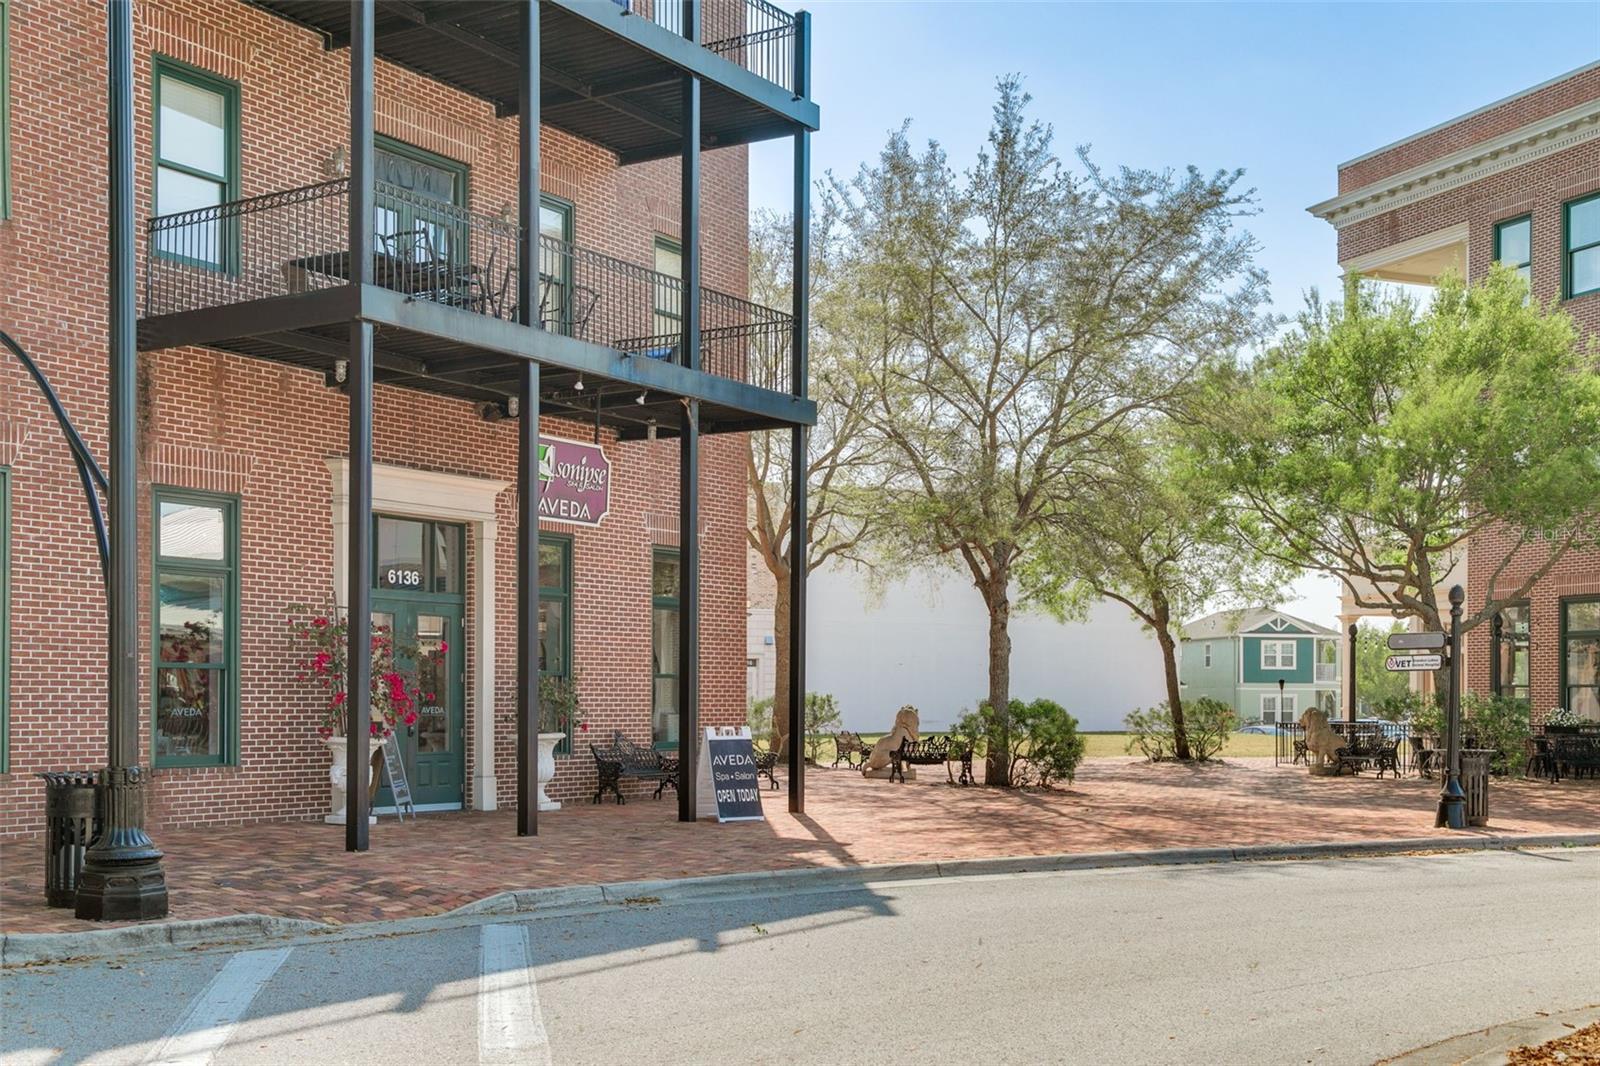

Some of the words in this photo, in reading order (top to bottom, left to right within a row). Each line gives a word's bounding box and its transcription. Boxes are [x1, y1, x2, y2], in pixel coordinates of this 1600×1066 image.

[539, 497, 591, 520] AVEDA
[388, 569, 420, 585] 6136
[1395, 660, 1412, 668] VET
[171, 707, 203, 717] AVEDA
[421, 706, 445, 714] AVEDA
[713, 754, 754, 766] AVEDA
[715, 771, 730, 781] Spa
[734, 771, 755, 781] Salon
[717, 789, 736, 802] OPEN
[736, 788, 759, 802] TODAY
